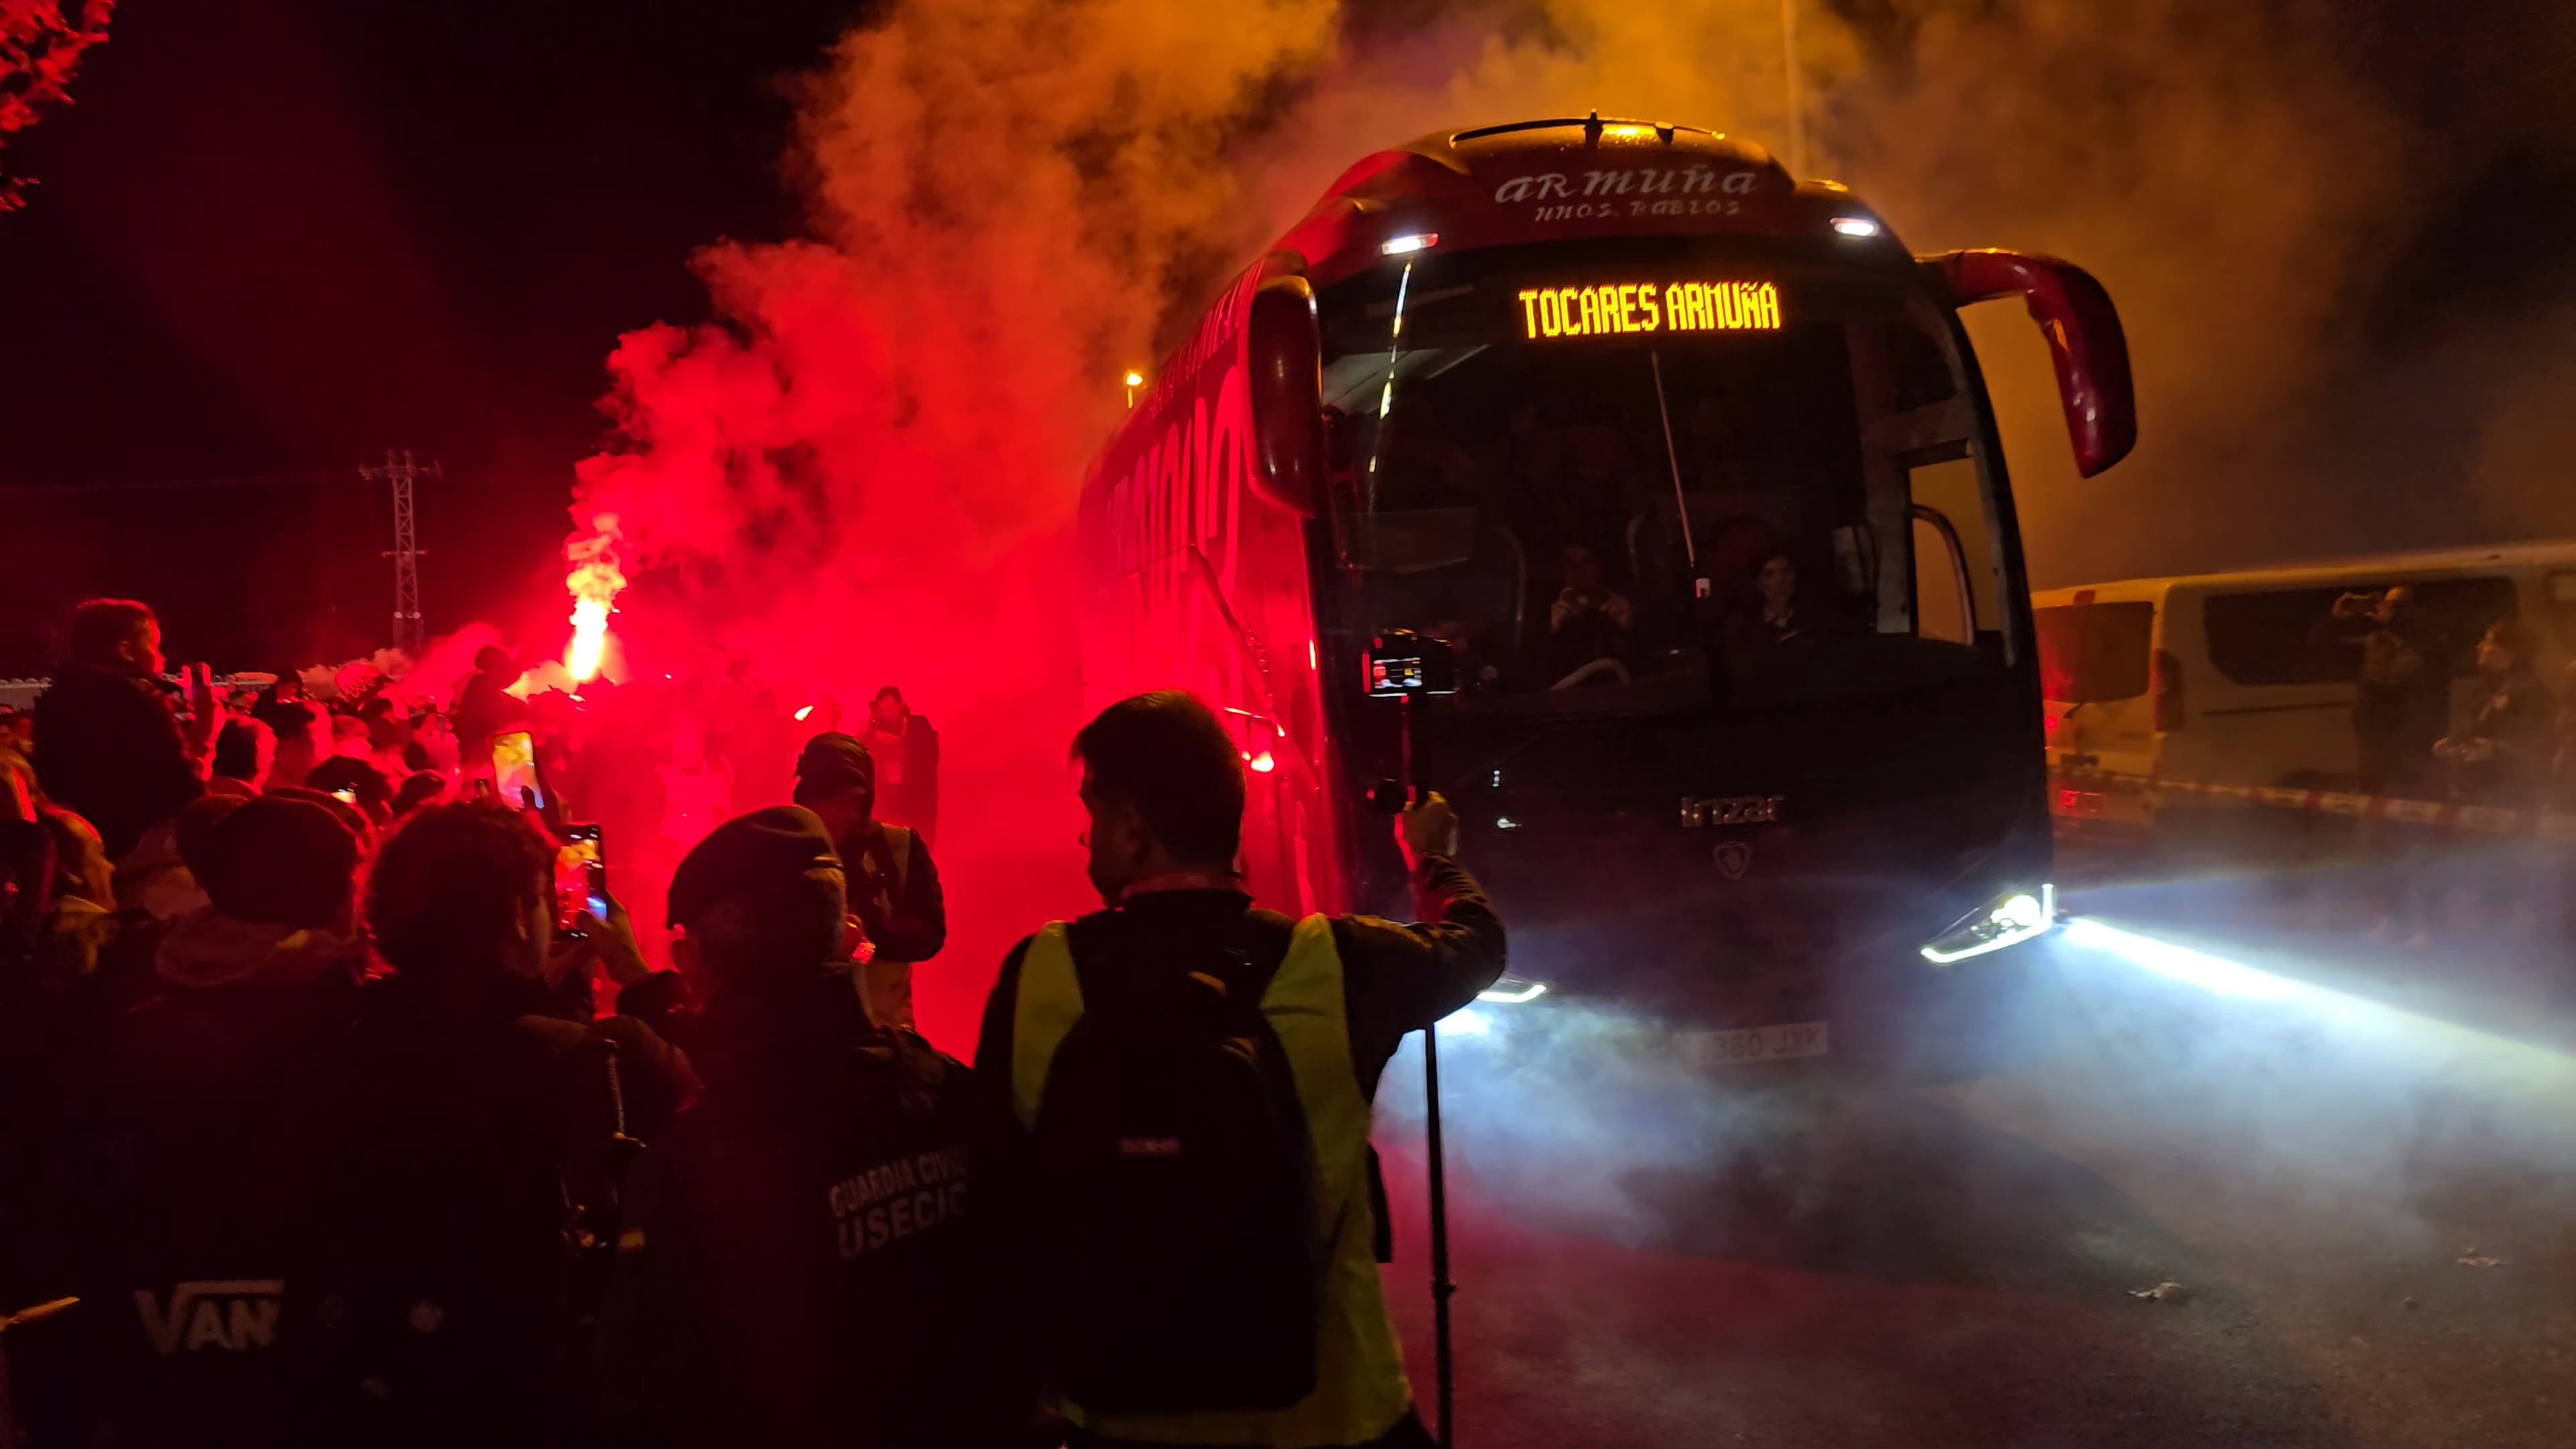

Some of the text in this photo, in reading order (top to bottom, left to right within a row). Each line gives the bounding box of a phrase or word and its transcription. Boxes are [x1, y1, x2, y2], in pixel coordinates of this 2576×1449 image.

[1519, 281, 1782, 338] TOCARES ARMUÑA
[828, 1159, 918, 1219] GUARDIA
[837, 1181, 967, 1260] USECIC
